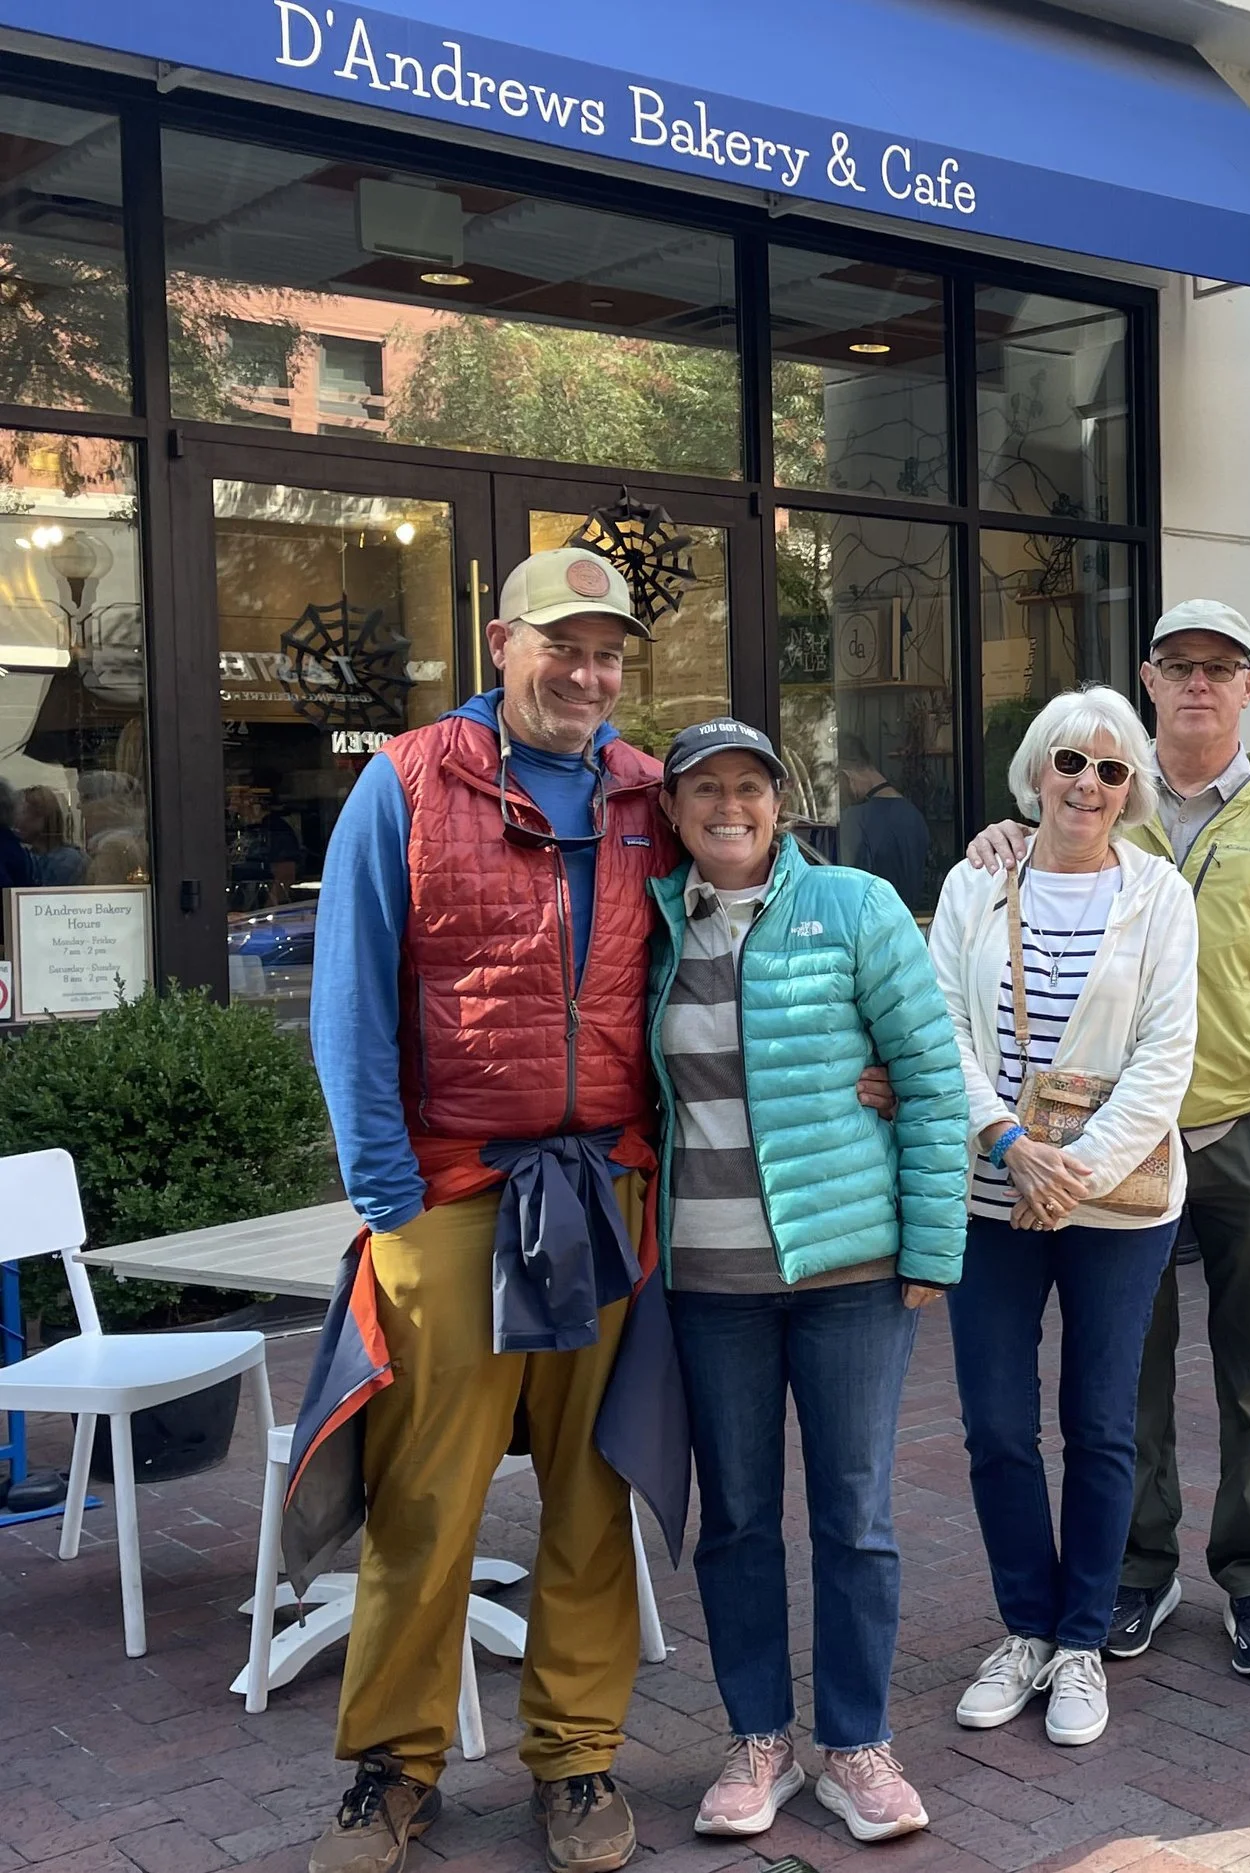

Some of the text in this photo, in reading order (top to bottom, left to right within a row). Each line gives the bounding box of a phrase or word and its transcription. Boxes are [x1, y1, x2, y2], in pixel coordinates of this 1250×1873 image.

[273, 0, 977, 214] D'Andrews Bakery & Cafe
[699, 723, 718, 735] YOU
[718, 723, 737, 732] GOT
[95, 903, 132, 915] Bakery
[67, 918, 101, 930] Hours
[52, 937, 85, 946] Monday
[92, 935, 117, 945] Friday
[48, 964, 85, 974] Saturday
[91, 962, 121, 972] Sunday
